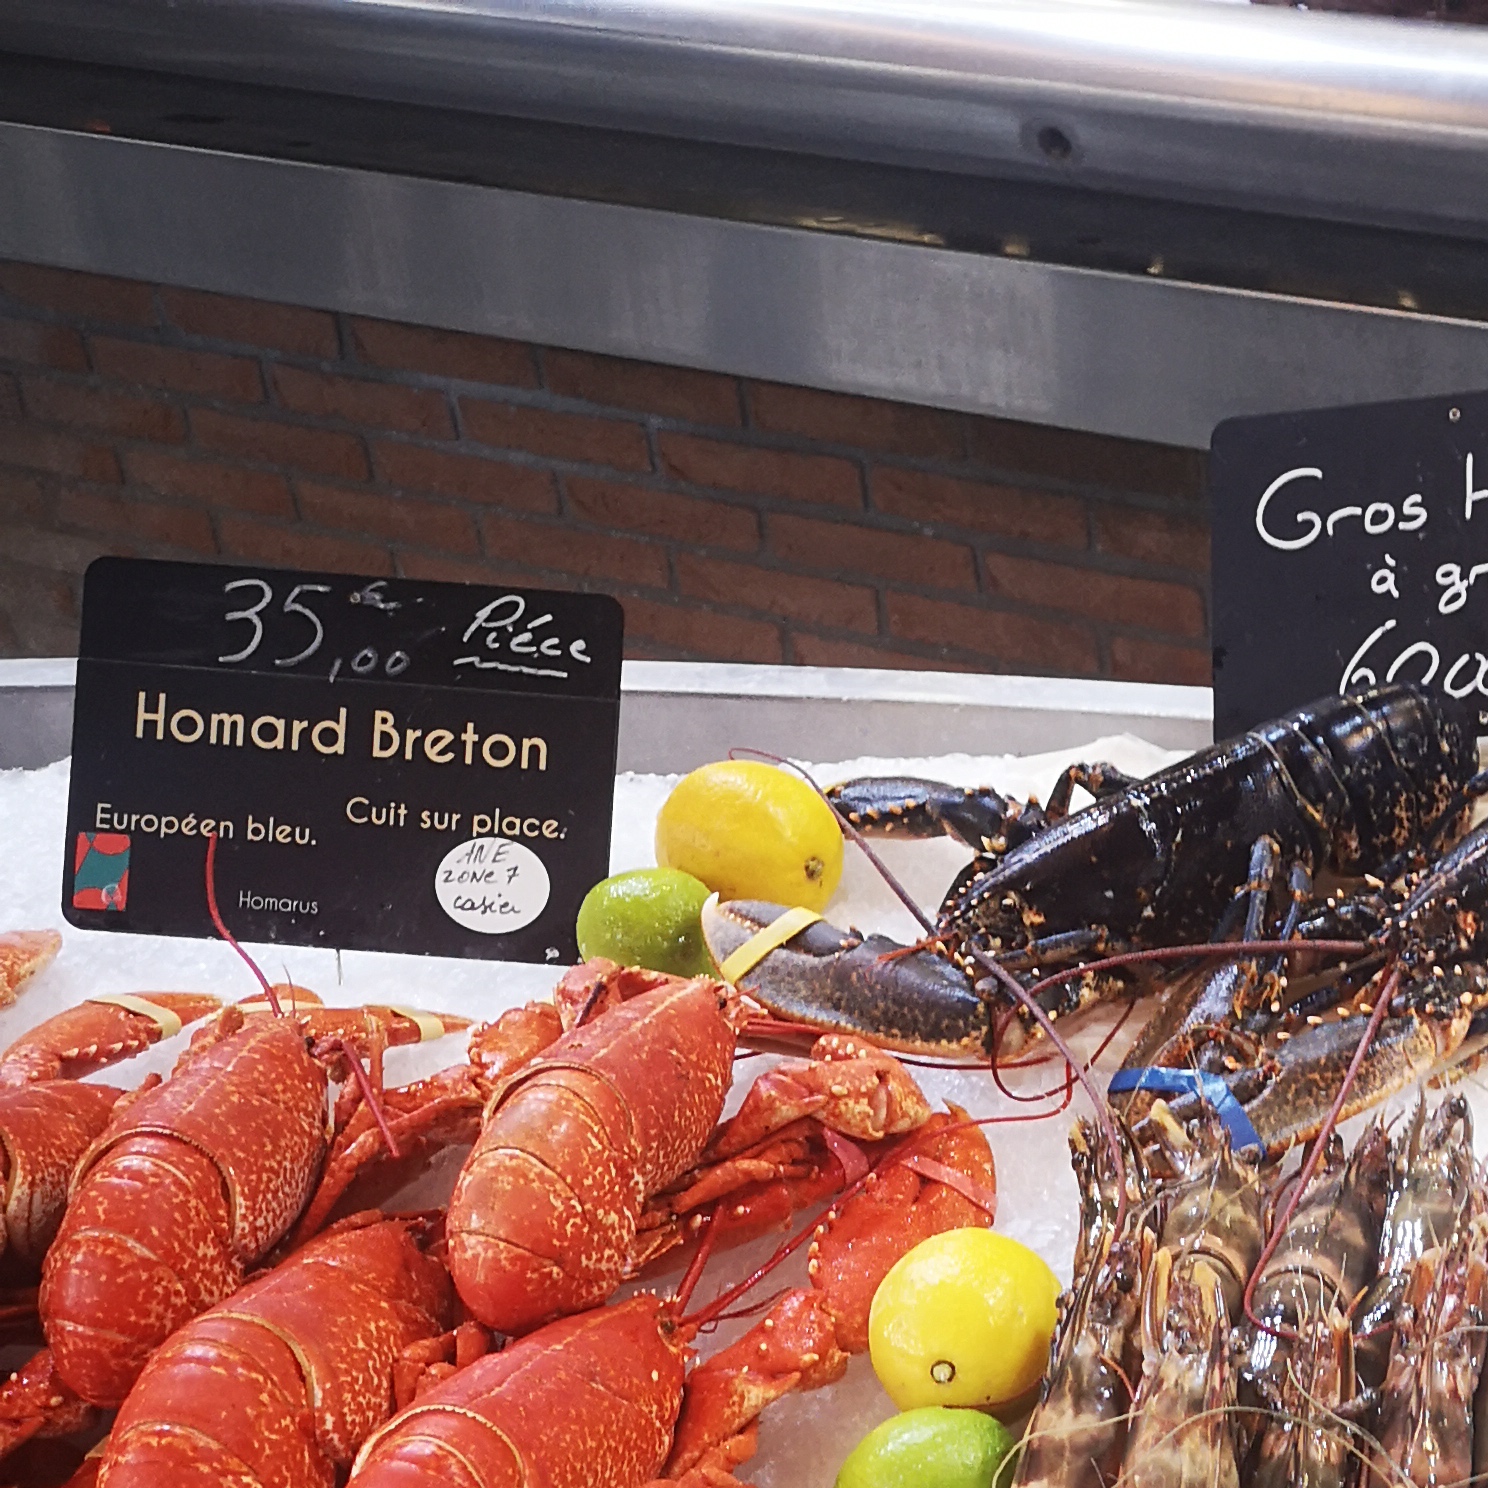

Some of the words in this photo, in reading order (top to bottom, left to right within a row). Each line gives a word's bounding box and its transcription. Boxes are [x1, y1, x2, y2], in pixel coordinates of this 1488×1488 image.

[1256, 466, 1428, 551] Gros
[1370, 553, 1400, 599] à
[135, 690, 347, 756] Homard
[371, 708, 549, 770] Breton
[95, 802, 234, 839] Européen
[246, 815, 317, 846] bleu.
[345, 797, 408, 827] Cuit
[419, 805, 461, 832] sur
[472, 807, 567, 839] place.
[506, 865, 520, 885] 7
[238, 889, 319, 914] Homarus
